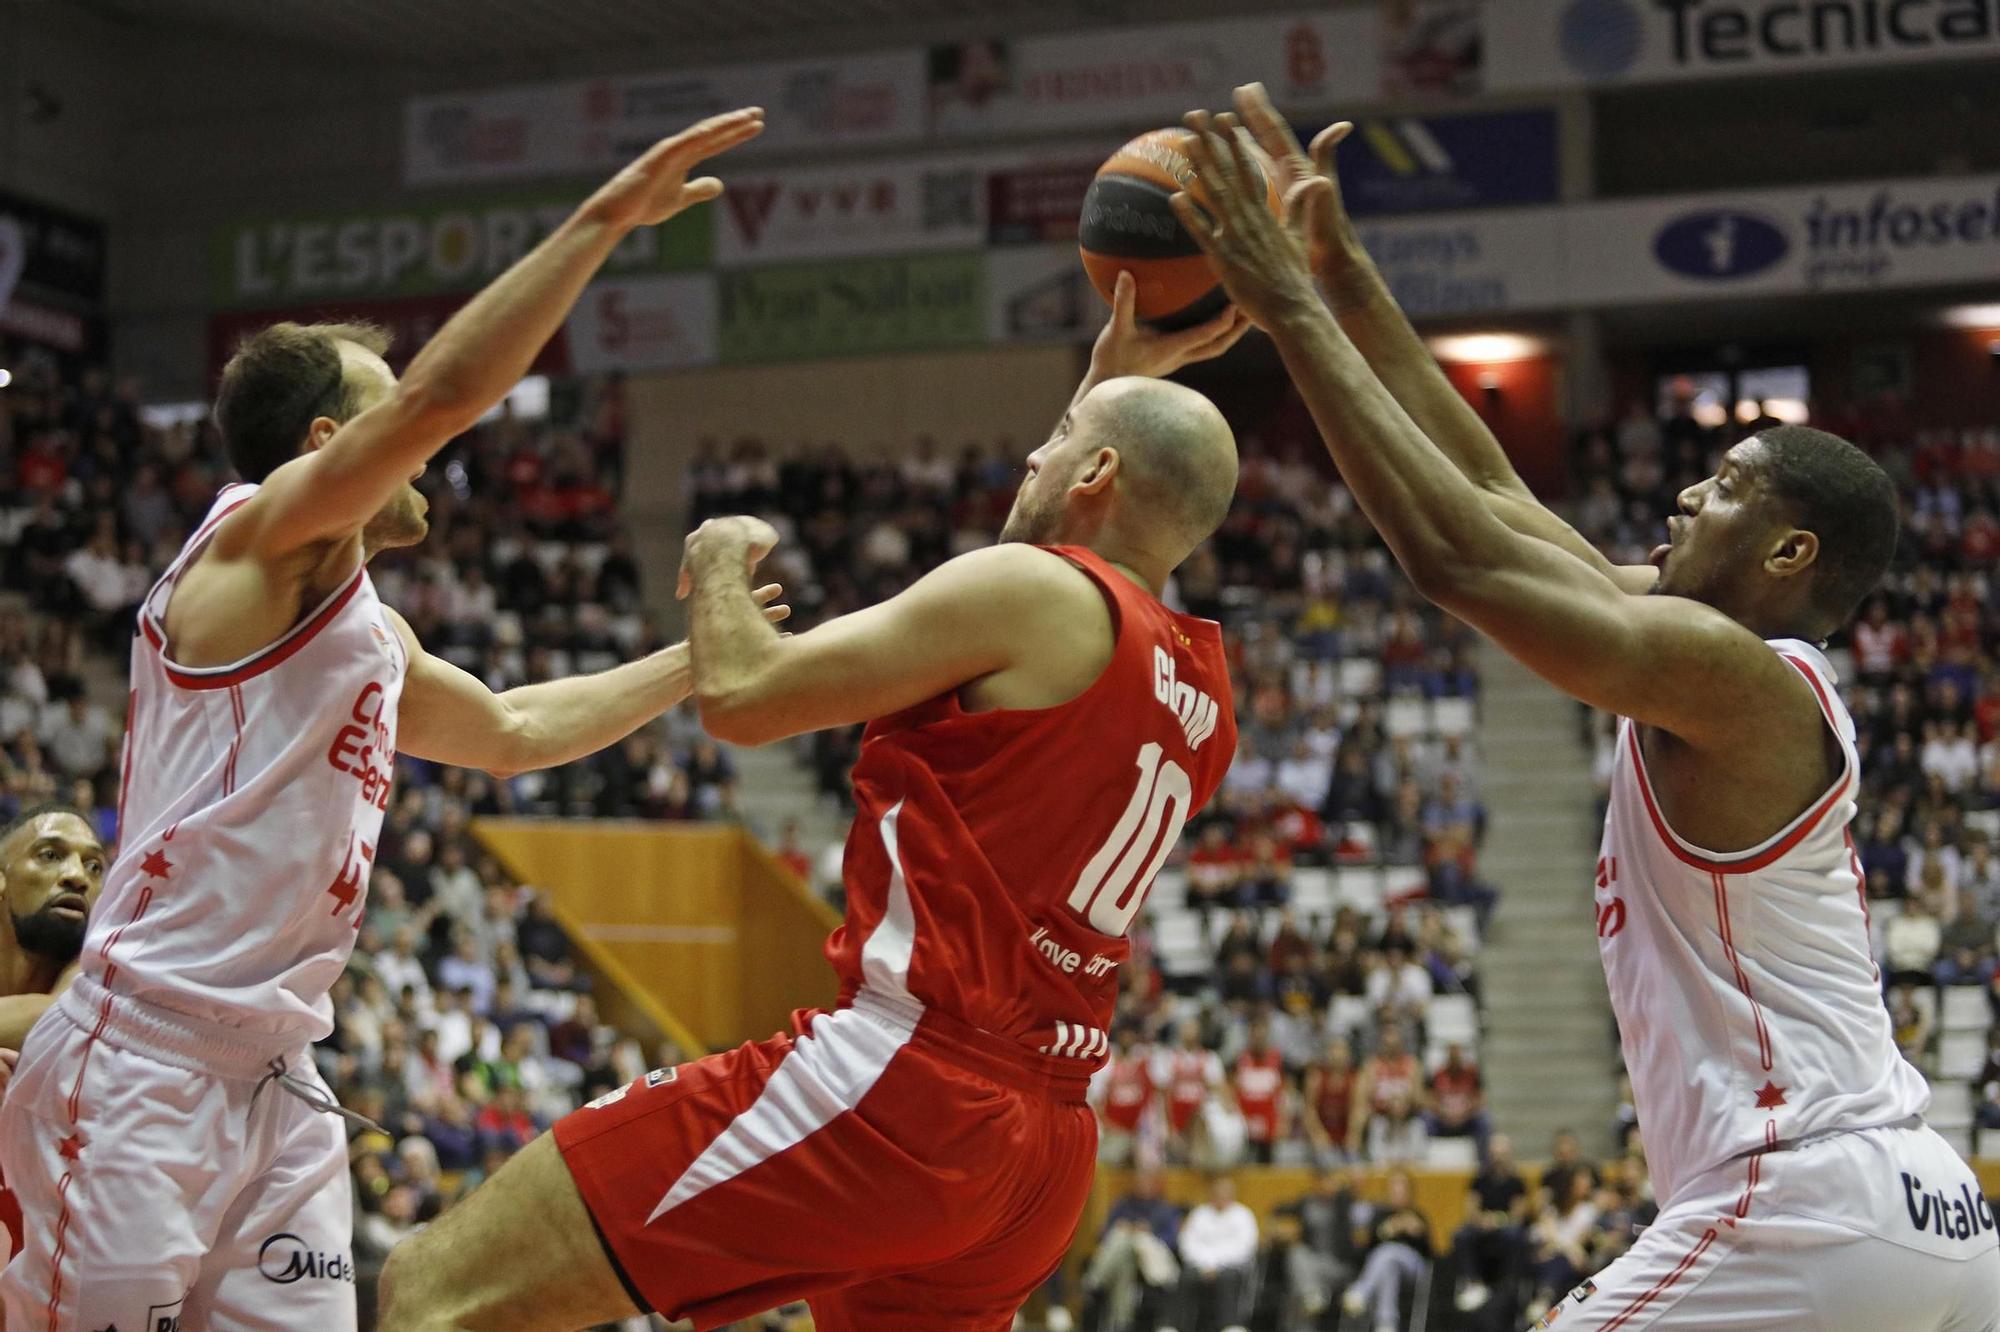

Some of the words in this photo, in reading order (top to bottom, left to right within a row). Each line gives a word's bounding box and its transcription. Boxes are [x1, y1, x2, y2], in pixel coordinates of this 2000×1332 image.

[1646, 0, 2000, 64] Tecnica
[1066, 741, 1192, 937] 10
[276, 1250, 356, 1284] Mide
